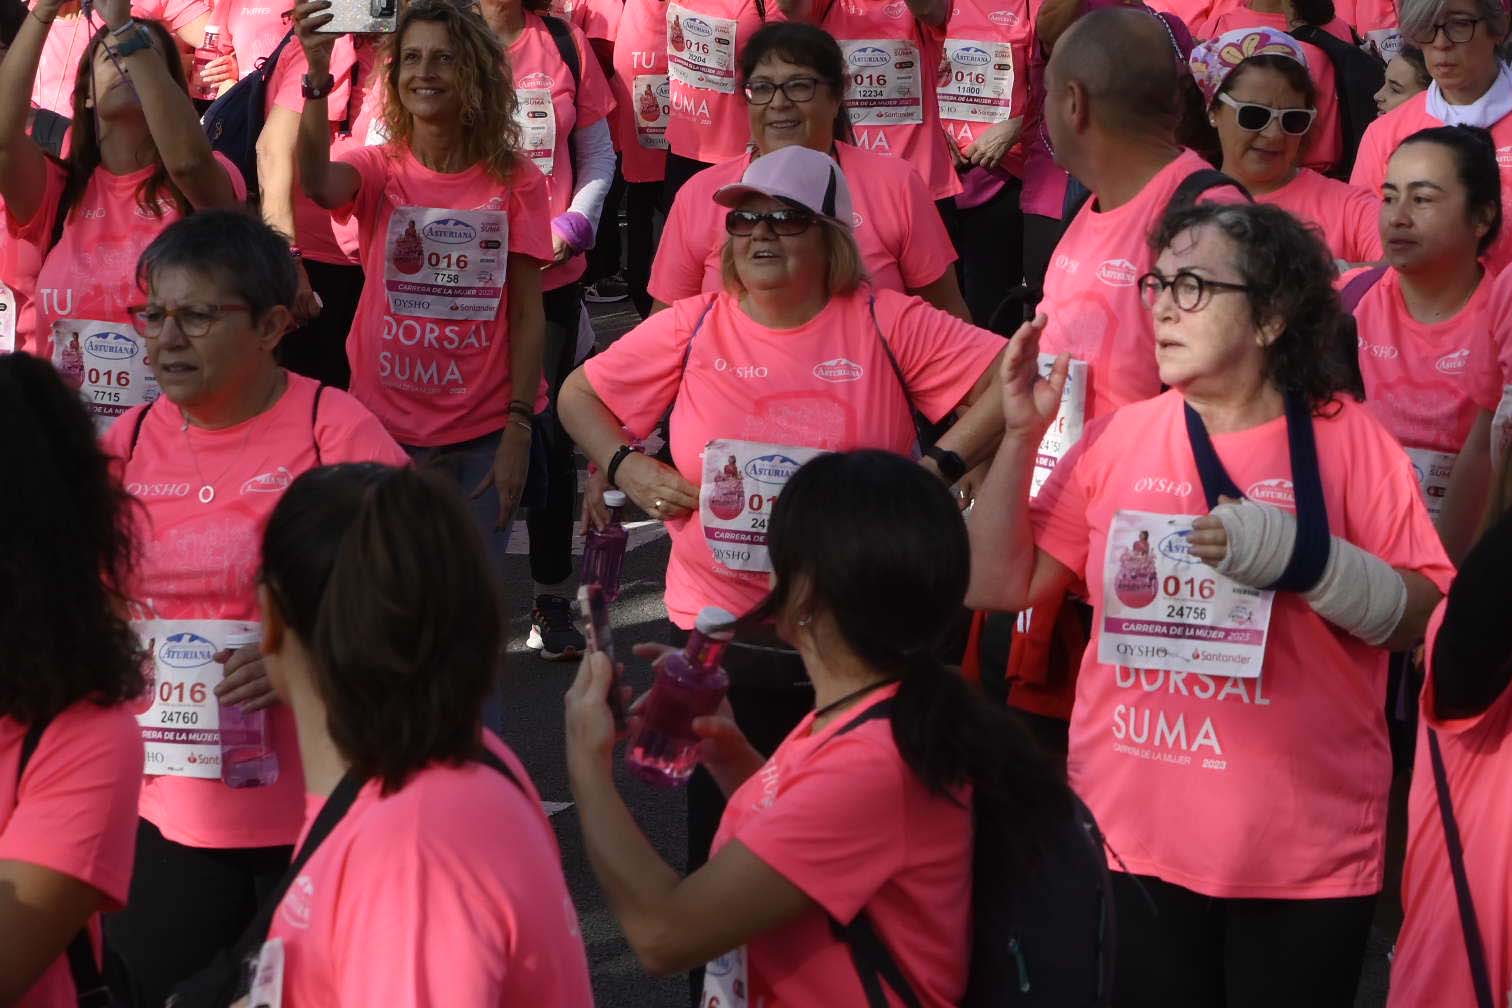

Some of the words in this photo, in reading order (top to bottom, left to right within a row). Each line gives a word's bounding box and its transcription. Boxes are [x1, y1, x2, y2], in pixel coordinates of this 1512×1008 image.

[686, 40, 710, 54] 016
[632, 52, 656, 70] TU
[853, 54, 888, 63] ASTURIANA
[955, 53, 989, 63] ASTURIANA
[854, 73, 887, 86] 016
[955, 71, 985, 84] 016
[858, 89, 884, 98] 12234
[673, 90, 710, 118] UMA
[425, 224, 472, 240] ASTURIANA
[427, 252, 468, 269] 016
[433, 271, 460, 284] 7758
[40, 288, 72, 315] TU
[394, 298, 431, 310] OYSHO
[459, 303, 496, 312] Santander
[383, 314, 490, 349] DORSAL
[87, 338, 135, 355] ASTURIANA
[379, 351, 464, 385] SUMA
[88, 368, 130, 387] 016
[93, 389, 120, 403] 7715
[1134, 478, 1193, 497] OYSHO
[1253, 487, 1294, 502] ASTURIA
[714, 530, 748, 542] CARRERA
[753, 535, 764, 543] DE
[1163, 575, 1217, 600] 016
[1167, 605, 1207, 621] 24756
[1122, 622, 1169, 635] CARRERA
[1170, 625, 1184, 636] DE
[1185, 626, 1195, 636] LA
[1195, 627, 1226, 640] MUJER
[1227, 630, 1251, 642] 2023
[1116, 643, 1168, 659] OYSHO
[1201, 649, 1252, 666] Santander
[160, 681, 207, 704] 016
[1113, 665, 1273, 706] DORSAL
[160, 711, 199, 725] 24760
[164, 731, 175, 741] DE
[176, 732, 187, 741] LA
[187, 732, 219, 743] MUJER
[1112, 703, 1225, 756] SUMA
[198, 753, 221, 766] Sant
